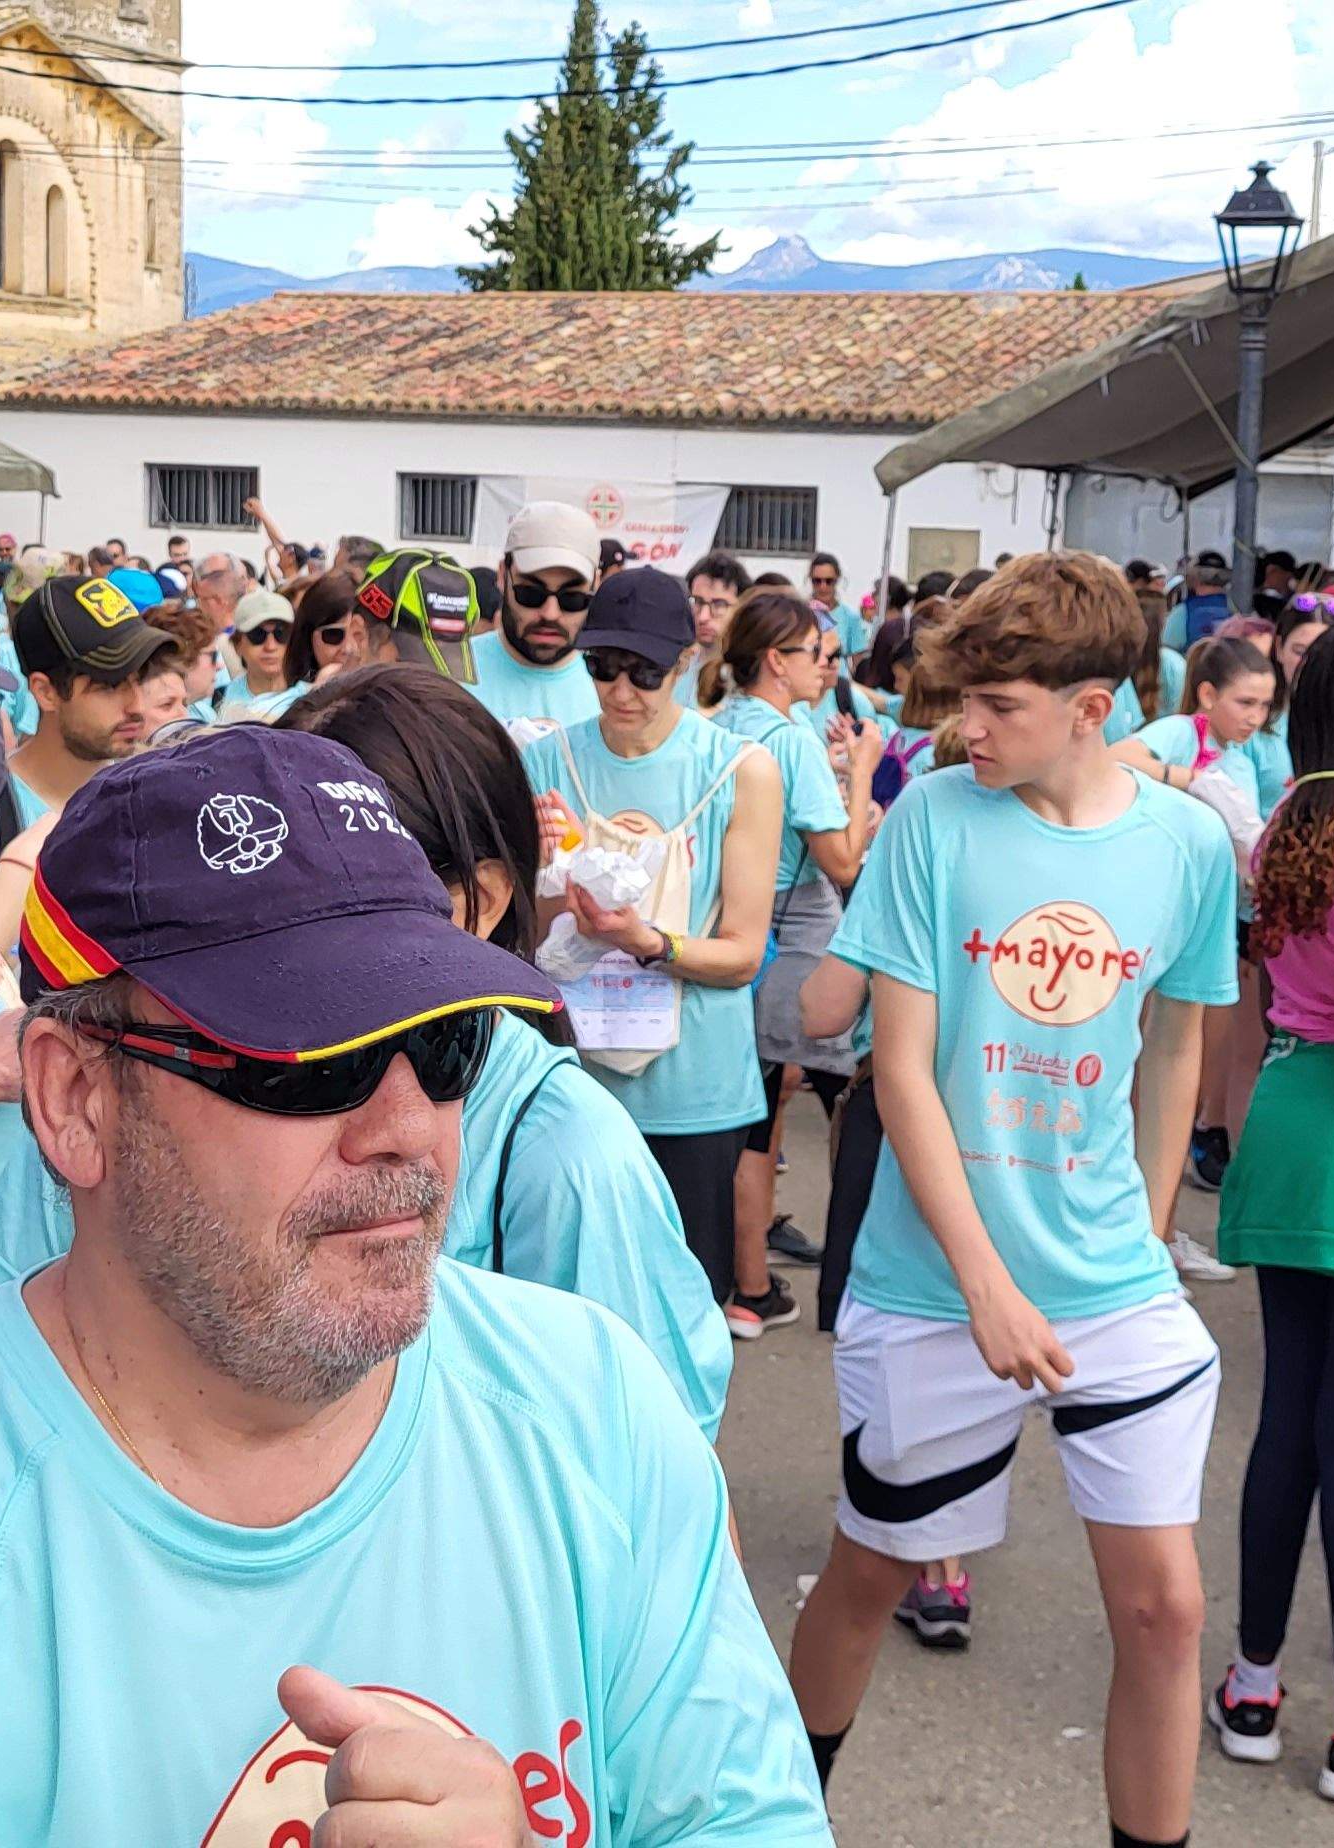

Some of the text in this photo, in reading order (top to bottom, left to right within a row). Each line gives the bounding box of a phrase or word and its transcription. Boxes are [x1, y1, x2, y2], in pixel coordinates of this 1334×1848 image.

[316, 781, 389, 811] DIFA
[963, 927, 1153, 993] +mayore
[982, 1042, 1008, 1073] 11
